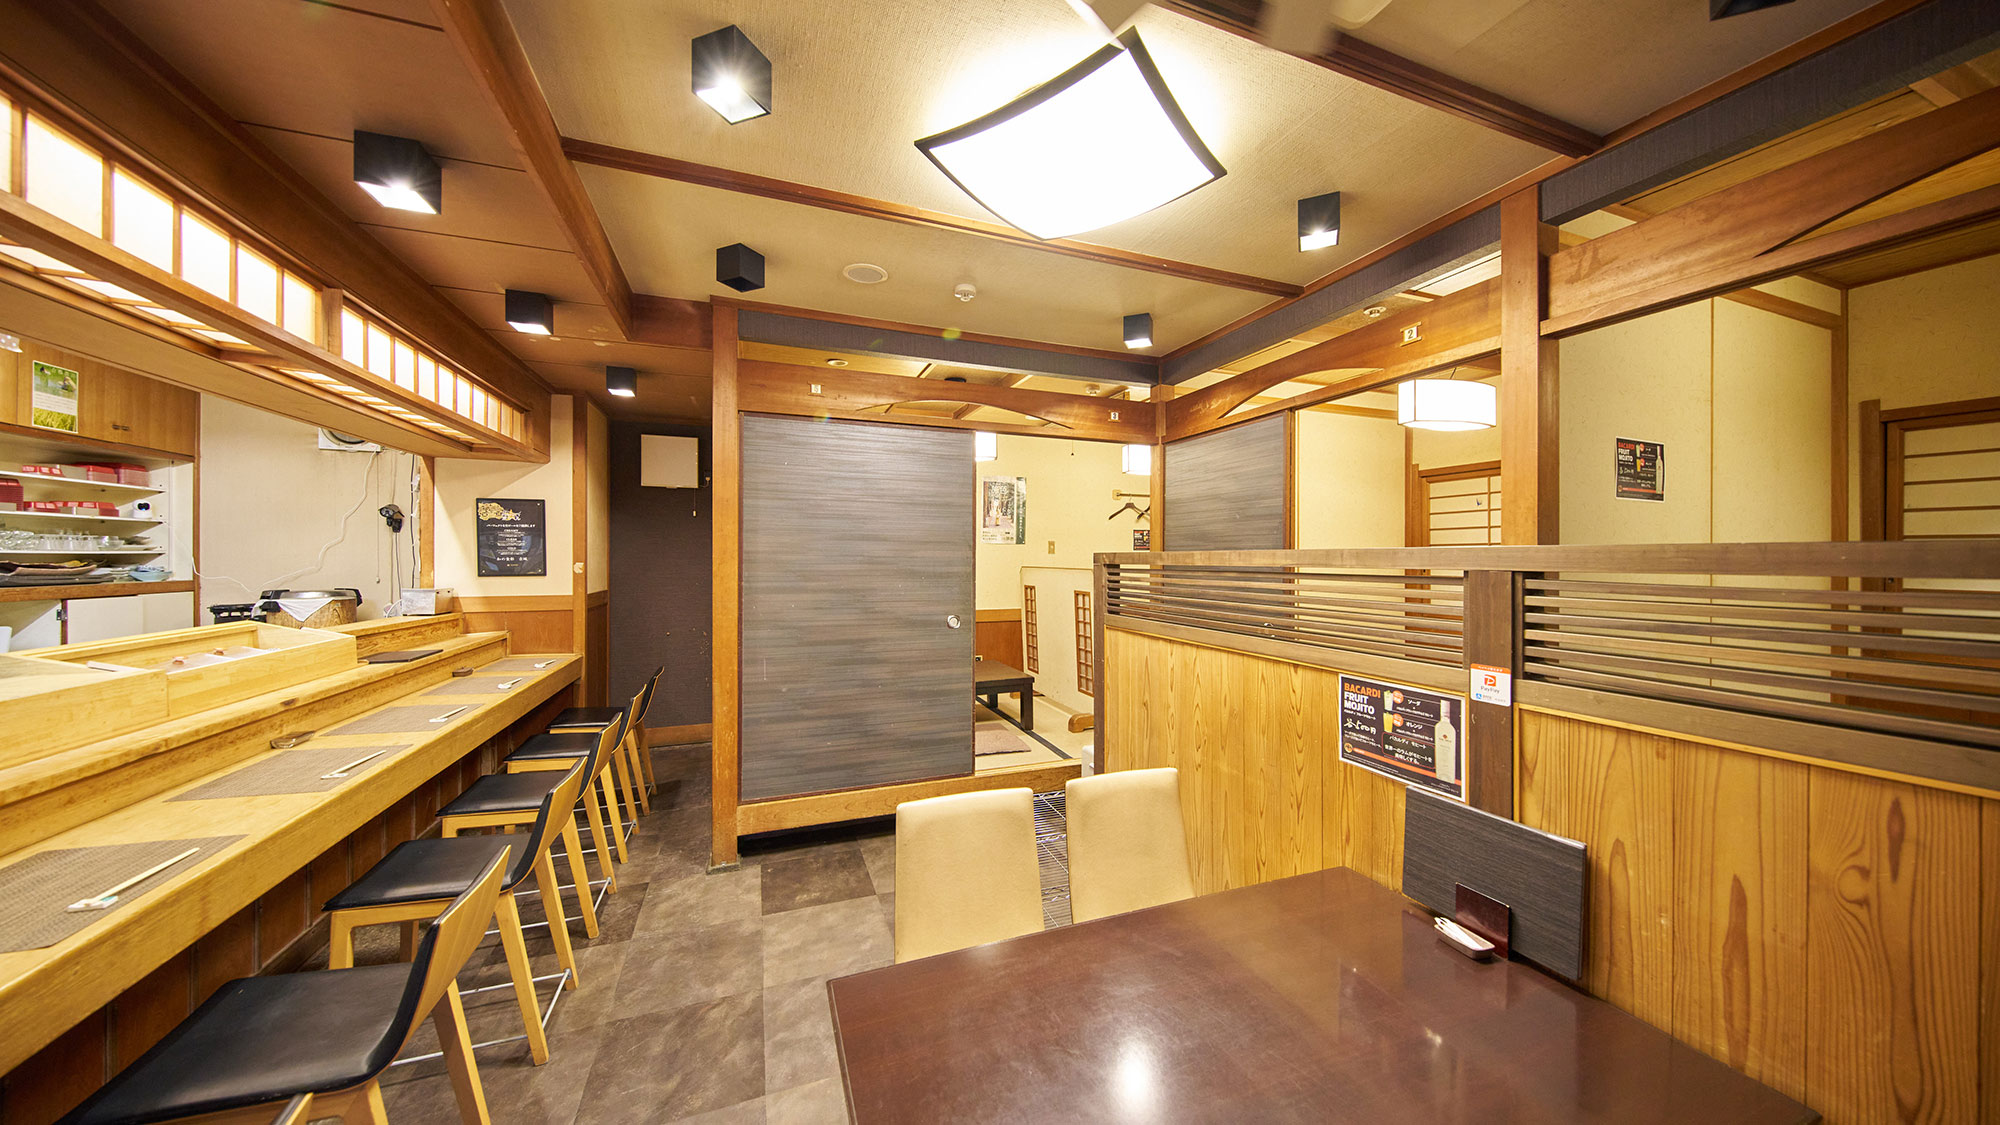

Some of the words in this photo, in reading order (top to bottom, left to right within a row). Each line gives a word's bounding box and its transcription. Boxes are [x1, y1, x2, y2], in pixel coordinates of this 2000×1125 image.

[1407, 329, 1413, 339] 2
[1344, 683, 1380, 698] BACARDI
[1344, 691, 1368, 704] FRUIT
[1407, 699, 1421, 707] ソーダ
[1344, 699, 1374, 714] MOJITO
